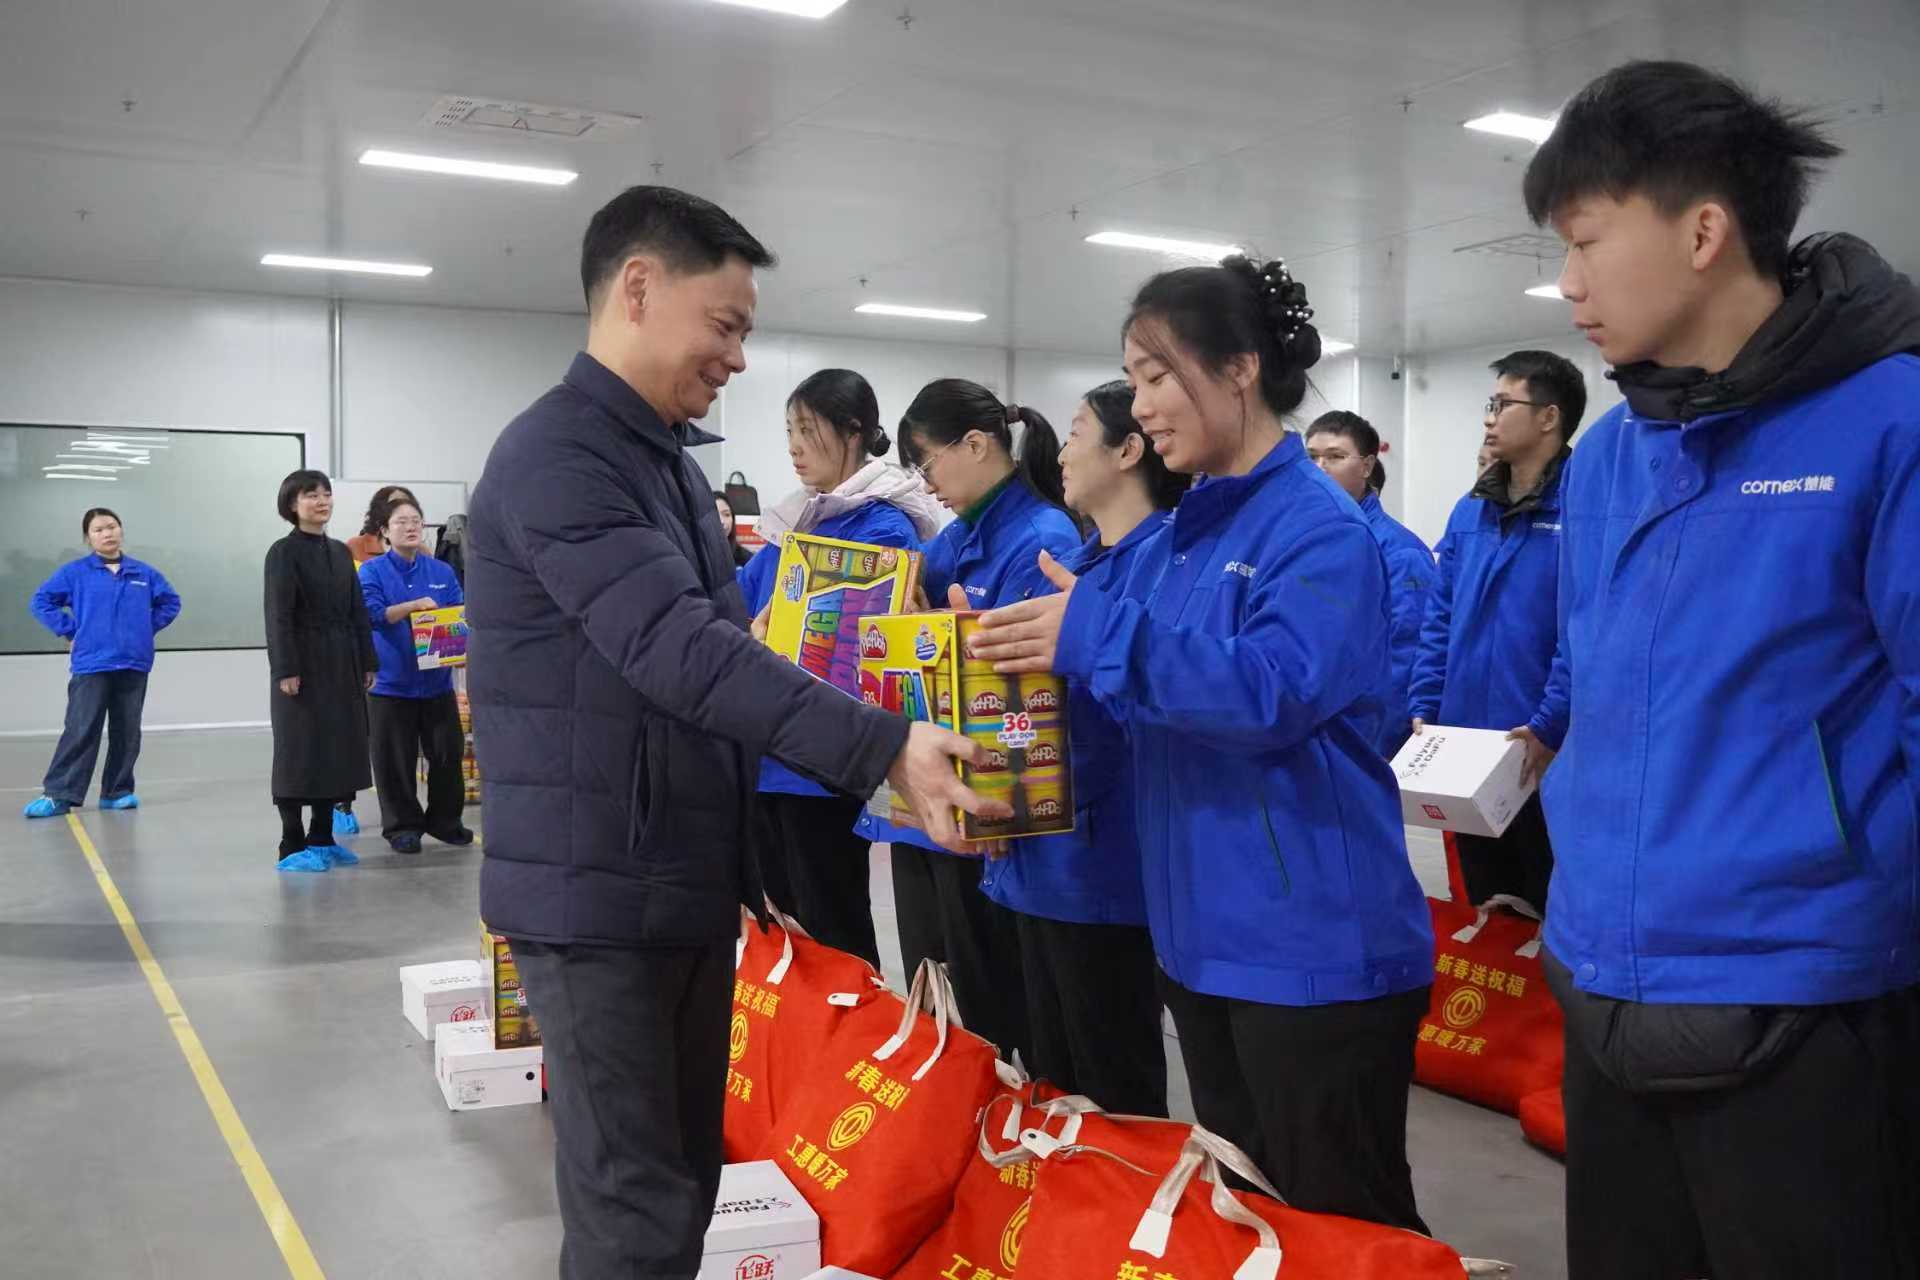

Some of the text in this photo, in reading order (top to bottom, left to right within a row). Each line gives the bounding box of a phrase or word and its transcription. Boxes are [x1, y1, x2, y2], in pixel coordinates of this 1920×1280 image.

[1741, 478, 1803, 494] cornex
[799, 589, 843, 678] MEGA
[1003, 713, 1031, 732] 36
[1435, 953, 1527, 998] 新春送祝福
[1417, 1023, 1487, 1056] 惠暖万家
[786, 1133, 849, 1191] 工惠暖万家
[738, 1257, 774, 1280] 飞跃
